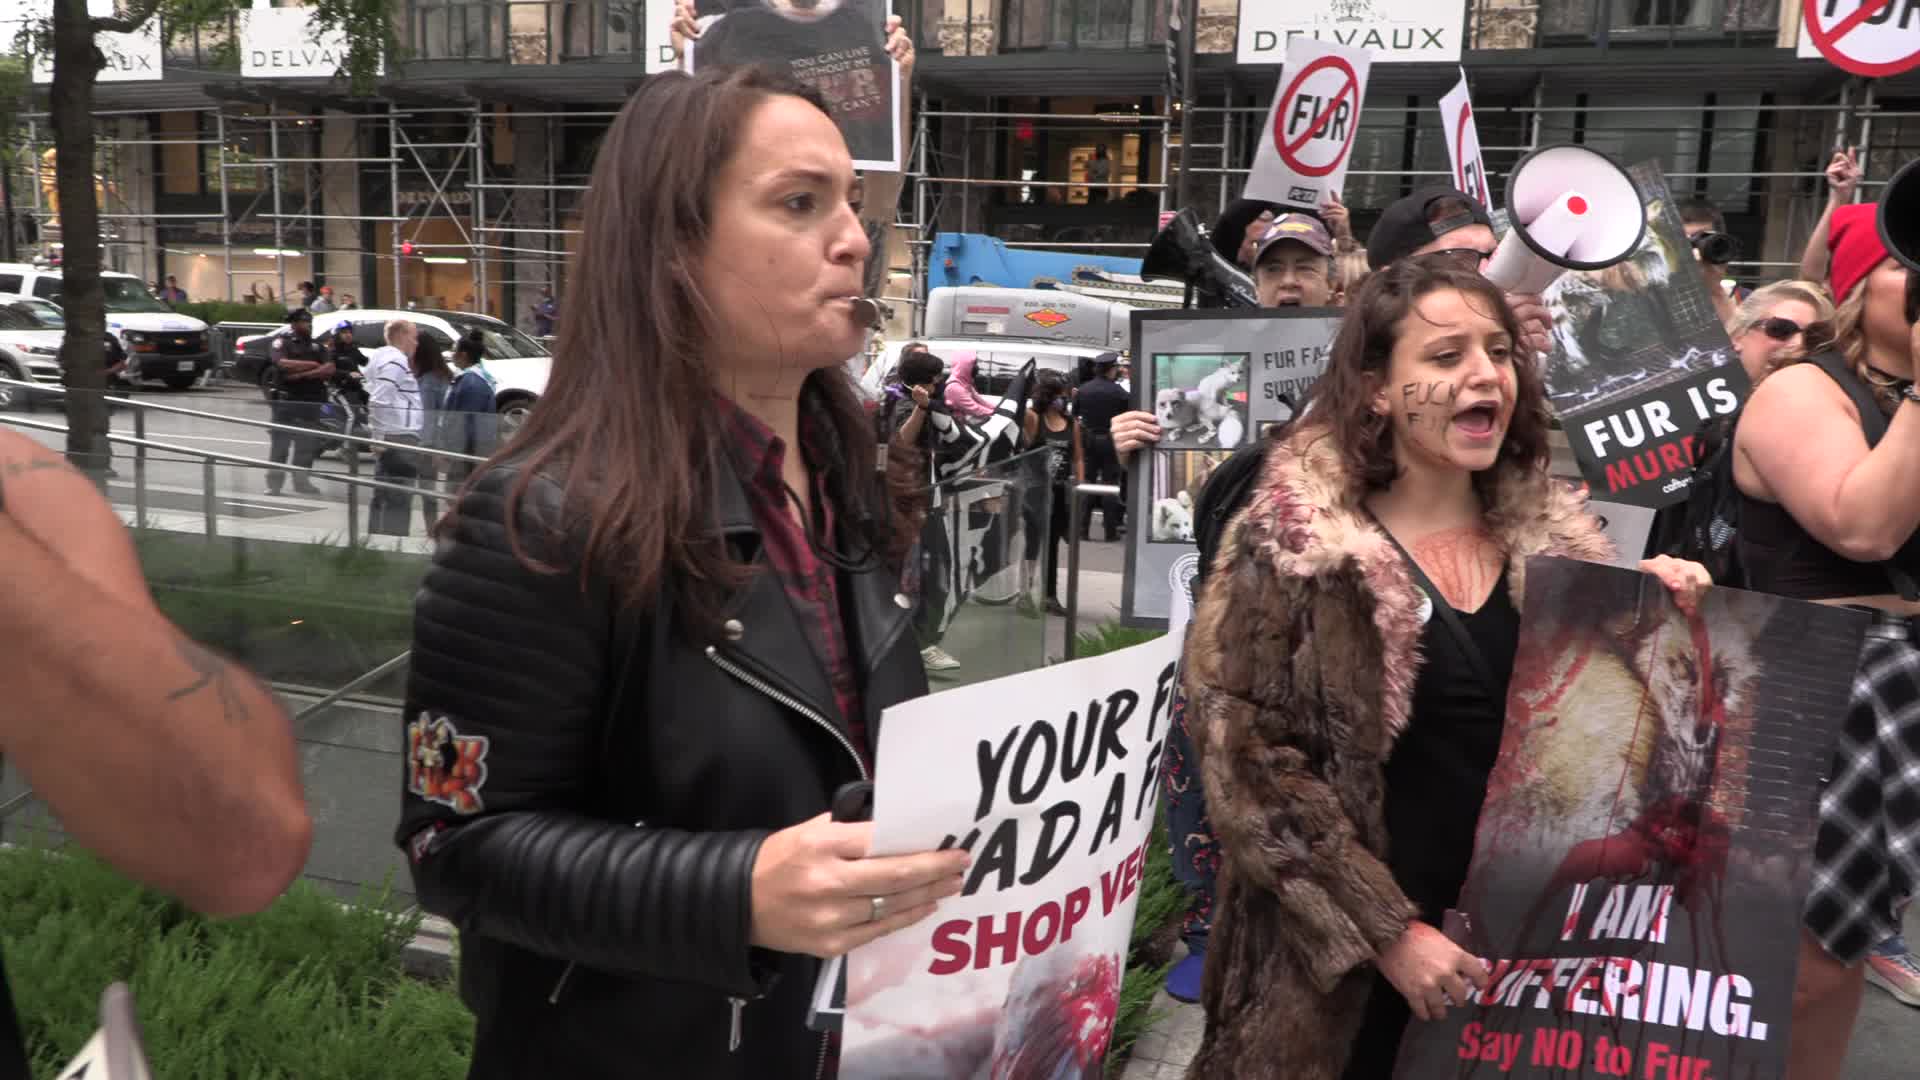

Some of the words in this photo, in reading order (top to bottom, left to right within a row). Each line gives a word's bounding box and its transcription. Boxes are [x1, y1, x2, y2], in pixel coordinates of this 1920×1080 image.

[252, 50, 337, 67] DELVA
[817, 49, 844, 64] CAN
[1254, 27, 1445, 51] DVAUX
[1288, 93, 1350, 141] FUR
[1263, 349, 1296, 369] FUR
[1301, 344, 1329, 367] FA
[1583, 400, 1680, 458] FUR
[1687, 377, 1738, 420] IS
[974, 688, 1139, 823] YOUR
[1089, 771, 1126, 855] A
[927, 886, 1091, 976] SHOP
[1560, 883, 1588, 941] I
[1591, 884, 1675, 944] AM
[1458, 1020, 1523, 1072] Say
[1531, 1027, 1583, 1070] NO
[1594, 1035, 1632, 1077] to
